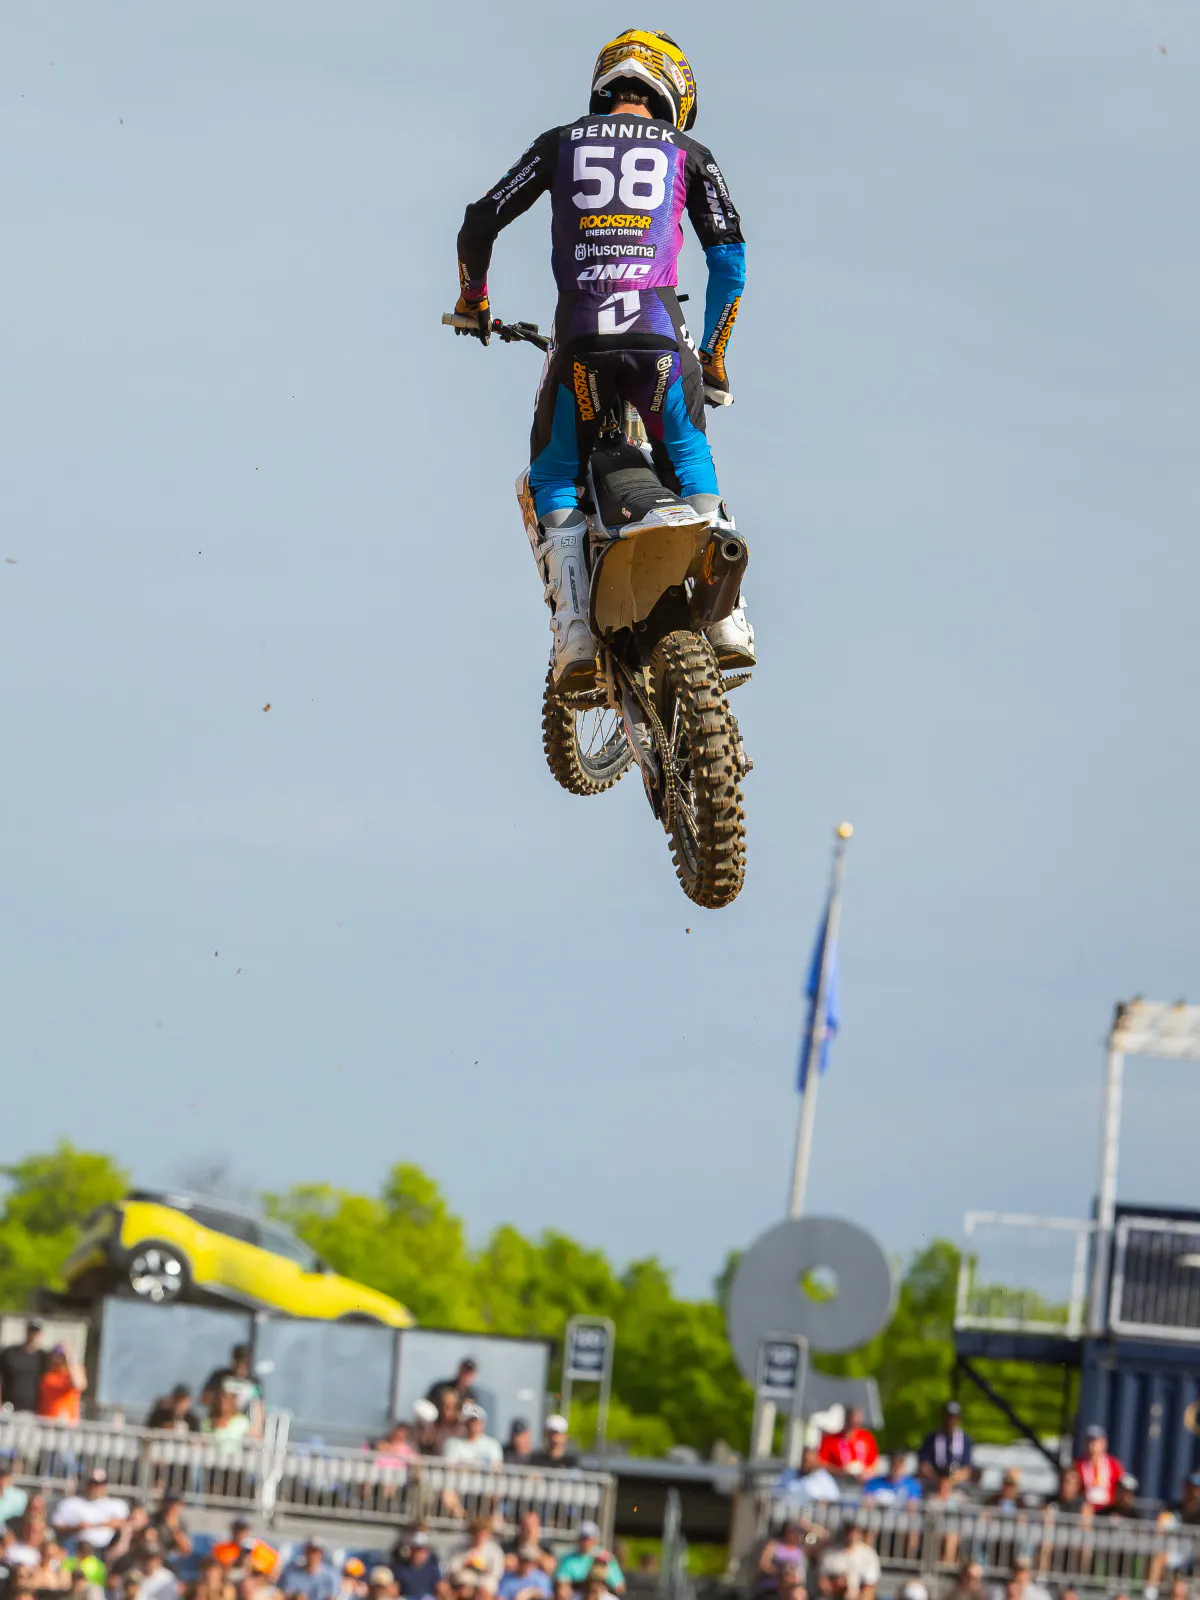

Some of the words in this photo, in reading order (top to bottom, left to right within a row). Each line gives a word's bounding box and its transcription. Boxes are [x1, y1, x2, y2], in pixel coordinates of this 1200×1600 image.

[570, 123, 675, 144] BENNICK
[571, 146, 669, 210] 58
[579, 214, 652, 229] ROCKSTAR
[586, 229, 616, 237] ENERGY
[587, 244, 655, 257] Husqvarna
[717, 303, 732, 330] ENERGY
[573, 361, 596, 421] ROCKSTAR
